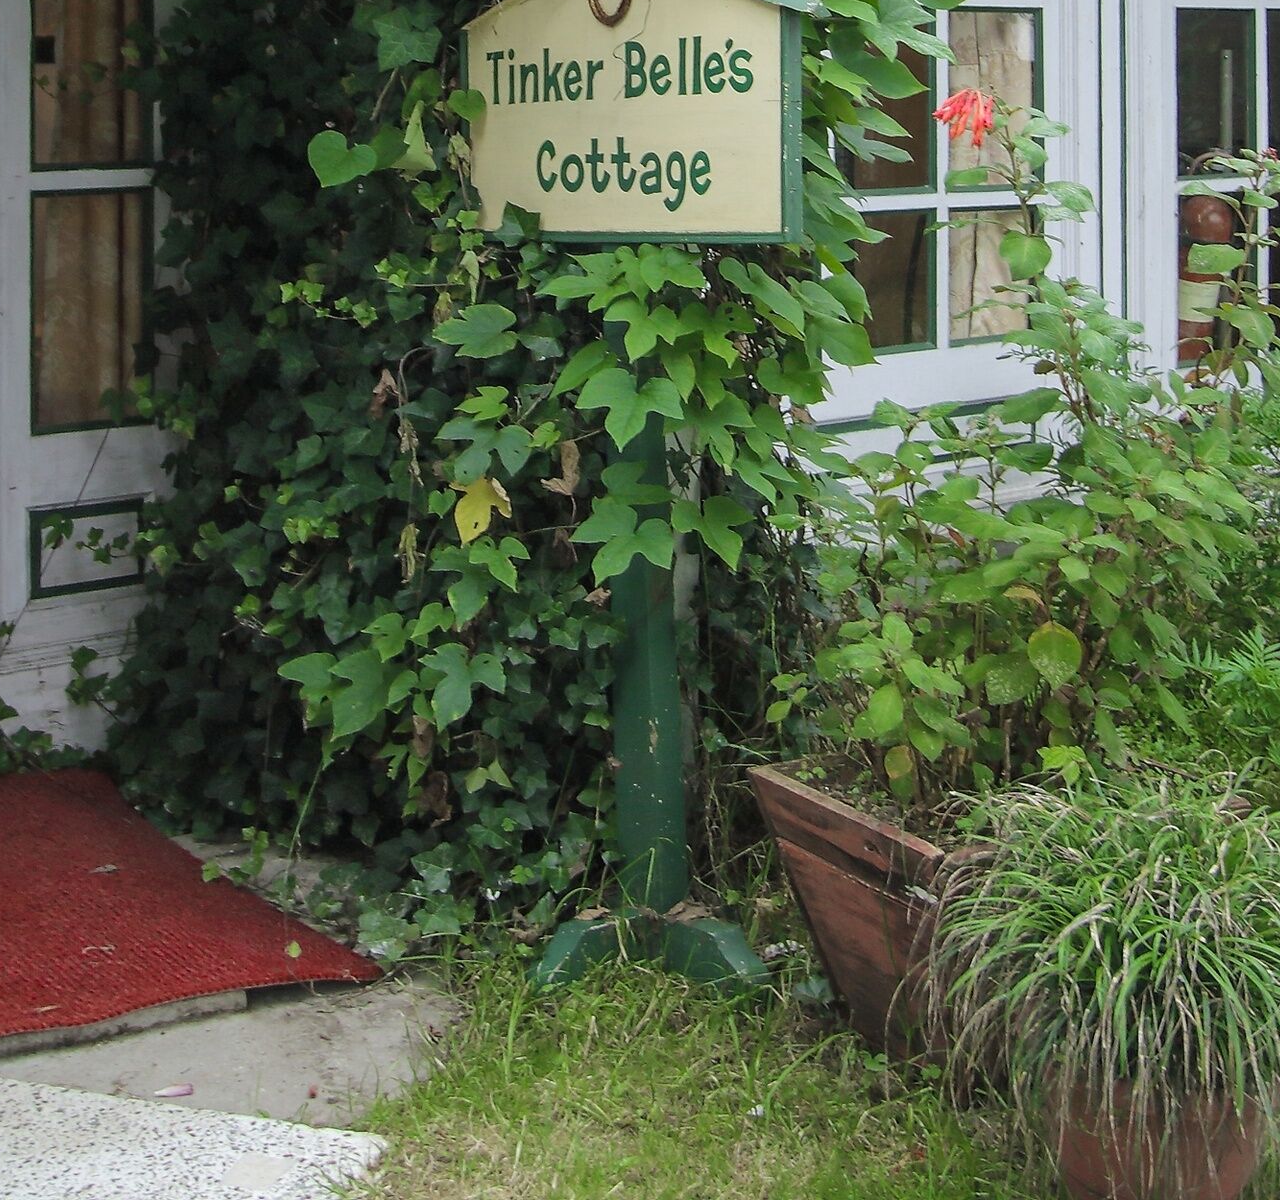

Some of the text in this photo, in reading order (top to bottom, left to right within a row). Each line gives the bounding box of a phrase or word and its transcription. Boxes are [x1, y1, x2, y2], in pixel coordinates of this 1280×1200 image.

[486, 35, 754, 105] Tinker Belle's
[536, 136, 712, 212] Cottage
